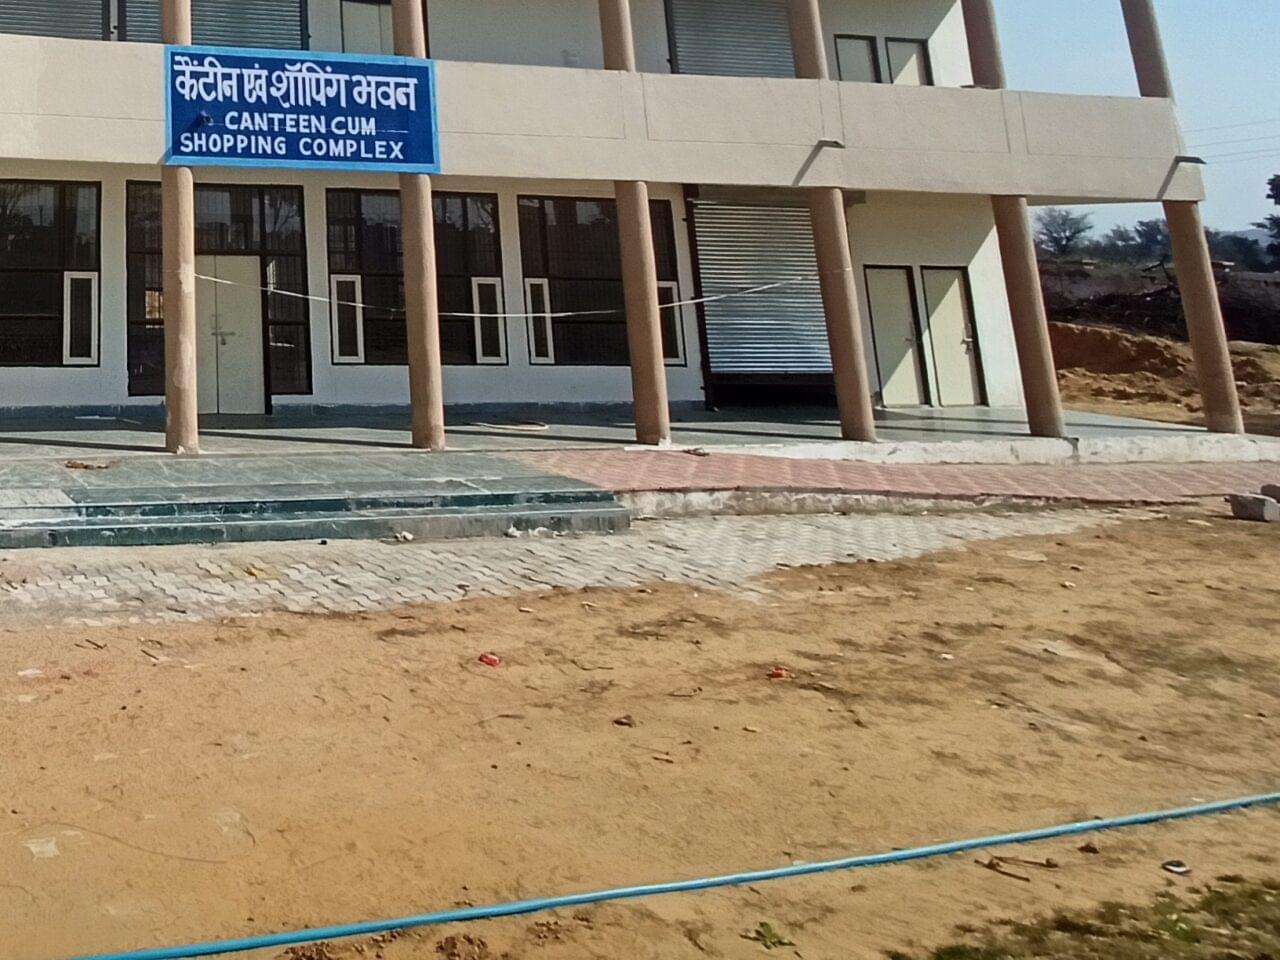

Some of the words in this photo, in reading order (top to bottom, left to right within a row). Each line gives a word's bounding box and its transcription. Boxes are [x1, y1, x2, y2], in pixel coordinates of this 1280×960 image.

[242, 63, 268, 105] एवं
[270, 62, 349, 108] शॉपिंग
[351, 75, 418, 111] भवन
[224, 111, 327, 134] CANTEEN
[331, 116, 376, 136] CUM
[180, 132, 287, 155] SHOPPING
[299, 137, 404, 160] COMPLEX
